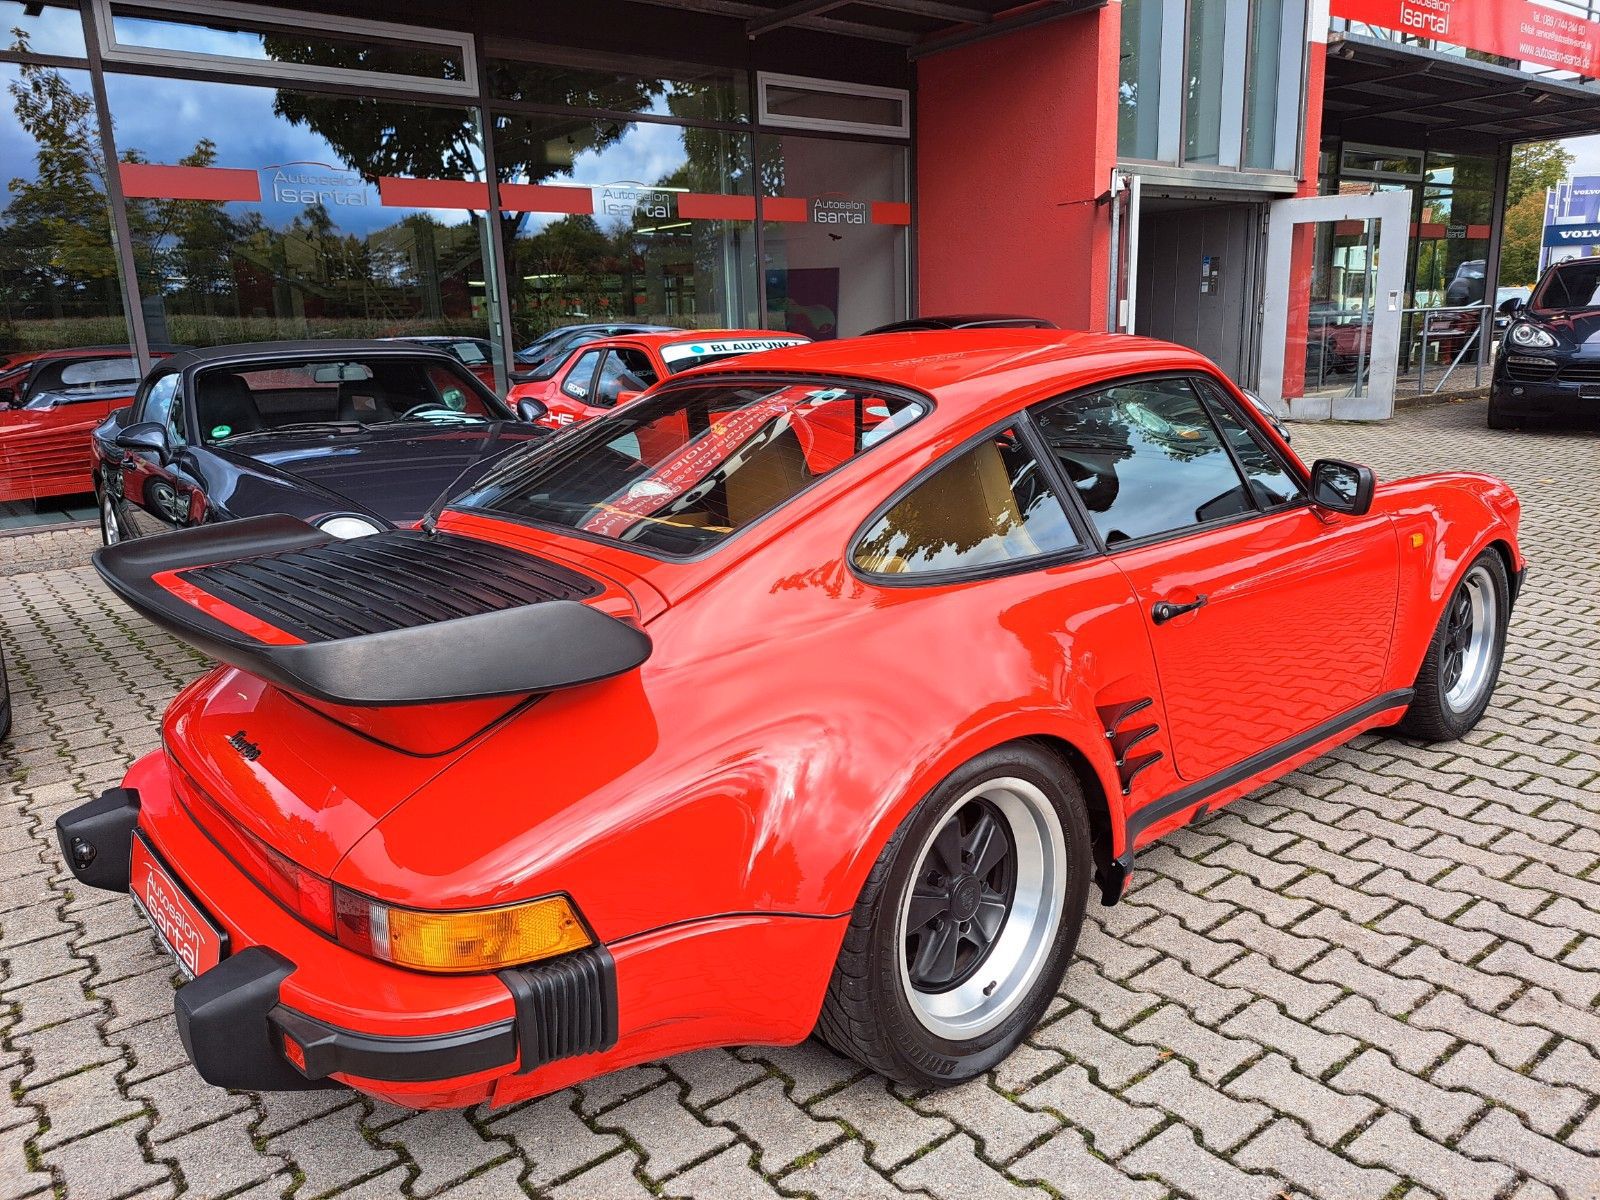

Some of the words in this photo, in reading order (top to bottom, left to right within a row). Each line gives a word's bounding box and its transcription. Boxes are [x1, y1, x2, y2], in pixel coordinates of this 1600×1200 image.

[1408, 0, 1450, 12] tosalon
[1400, 1, 1450, 34] Isartal
[273, 183, 368, 206] Isartal
[603, 188, 670, 202] Autosalon
[814, 198, 866, 210] Autosalon
[603, 199, 671, 218] Isartal
[814, 208, 866, 224] Isartal
[147, 871, 199, 943] Autosalon
[146, 881, 199, 977] Isartal
